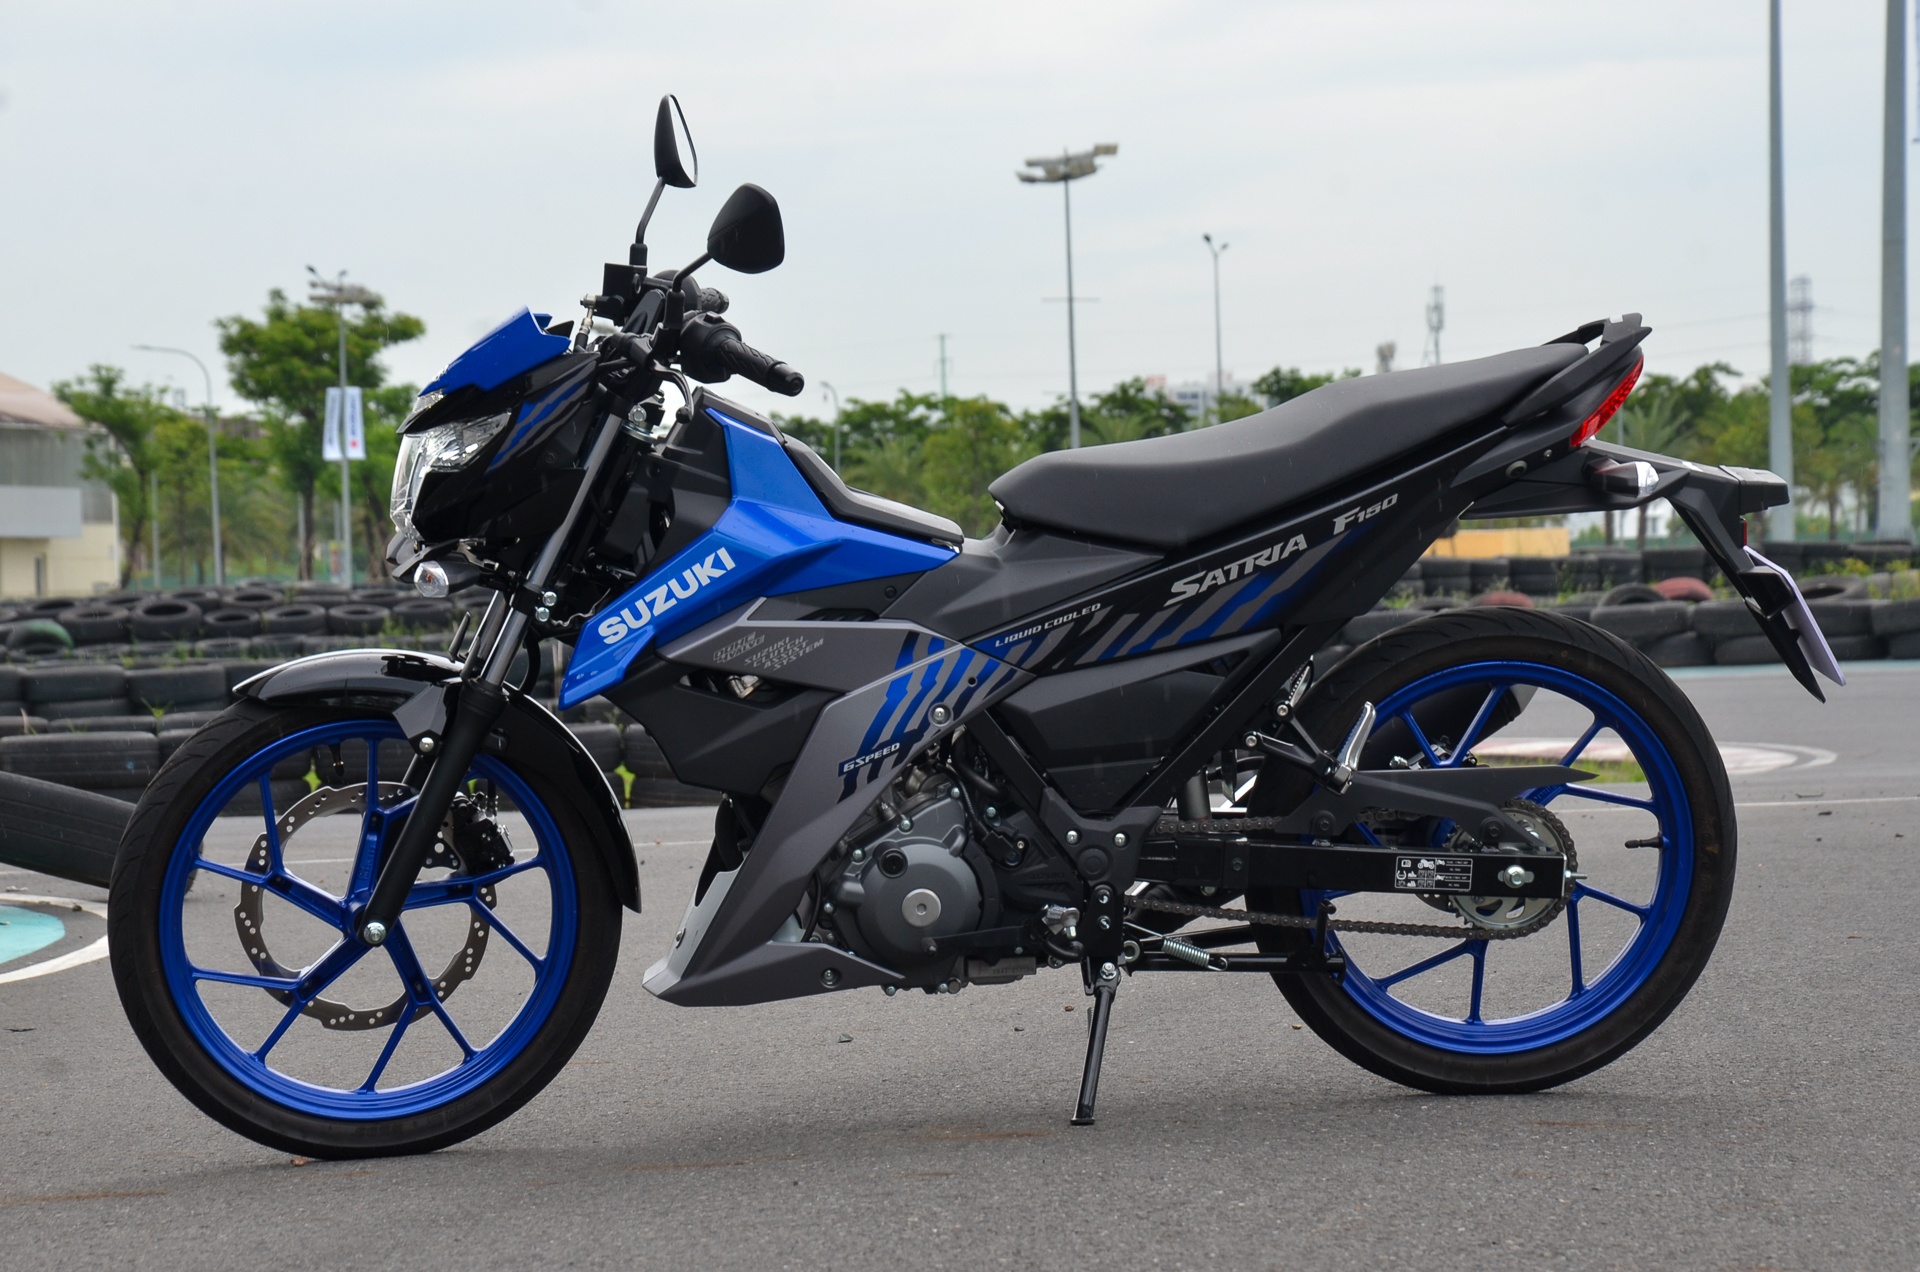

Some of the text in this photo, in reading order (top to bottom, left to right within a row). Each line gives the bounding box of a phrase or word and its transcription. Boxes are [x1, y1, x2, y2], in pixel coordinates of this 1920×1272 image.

[1164, 493, 1399, 607] SATRIA F150
[598, 547, 736, 645] SUZUKI
[995, 602, 1101, 648] LIQUID COOLED
[743, 636, 790, 665] SUZUKI
[752, 635, 804, 668] CLUTCH
[763, 640, 809, 670] ASSIST
[773, 638, 825, 671] SYSTEM
